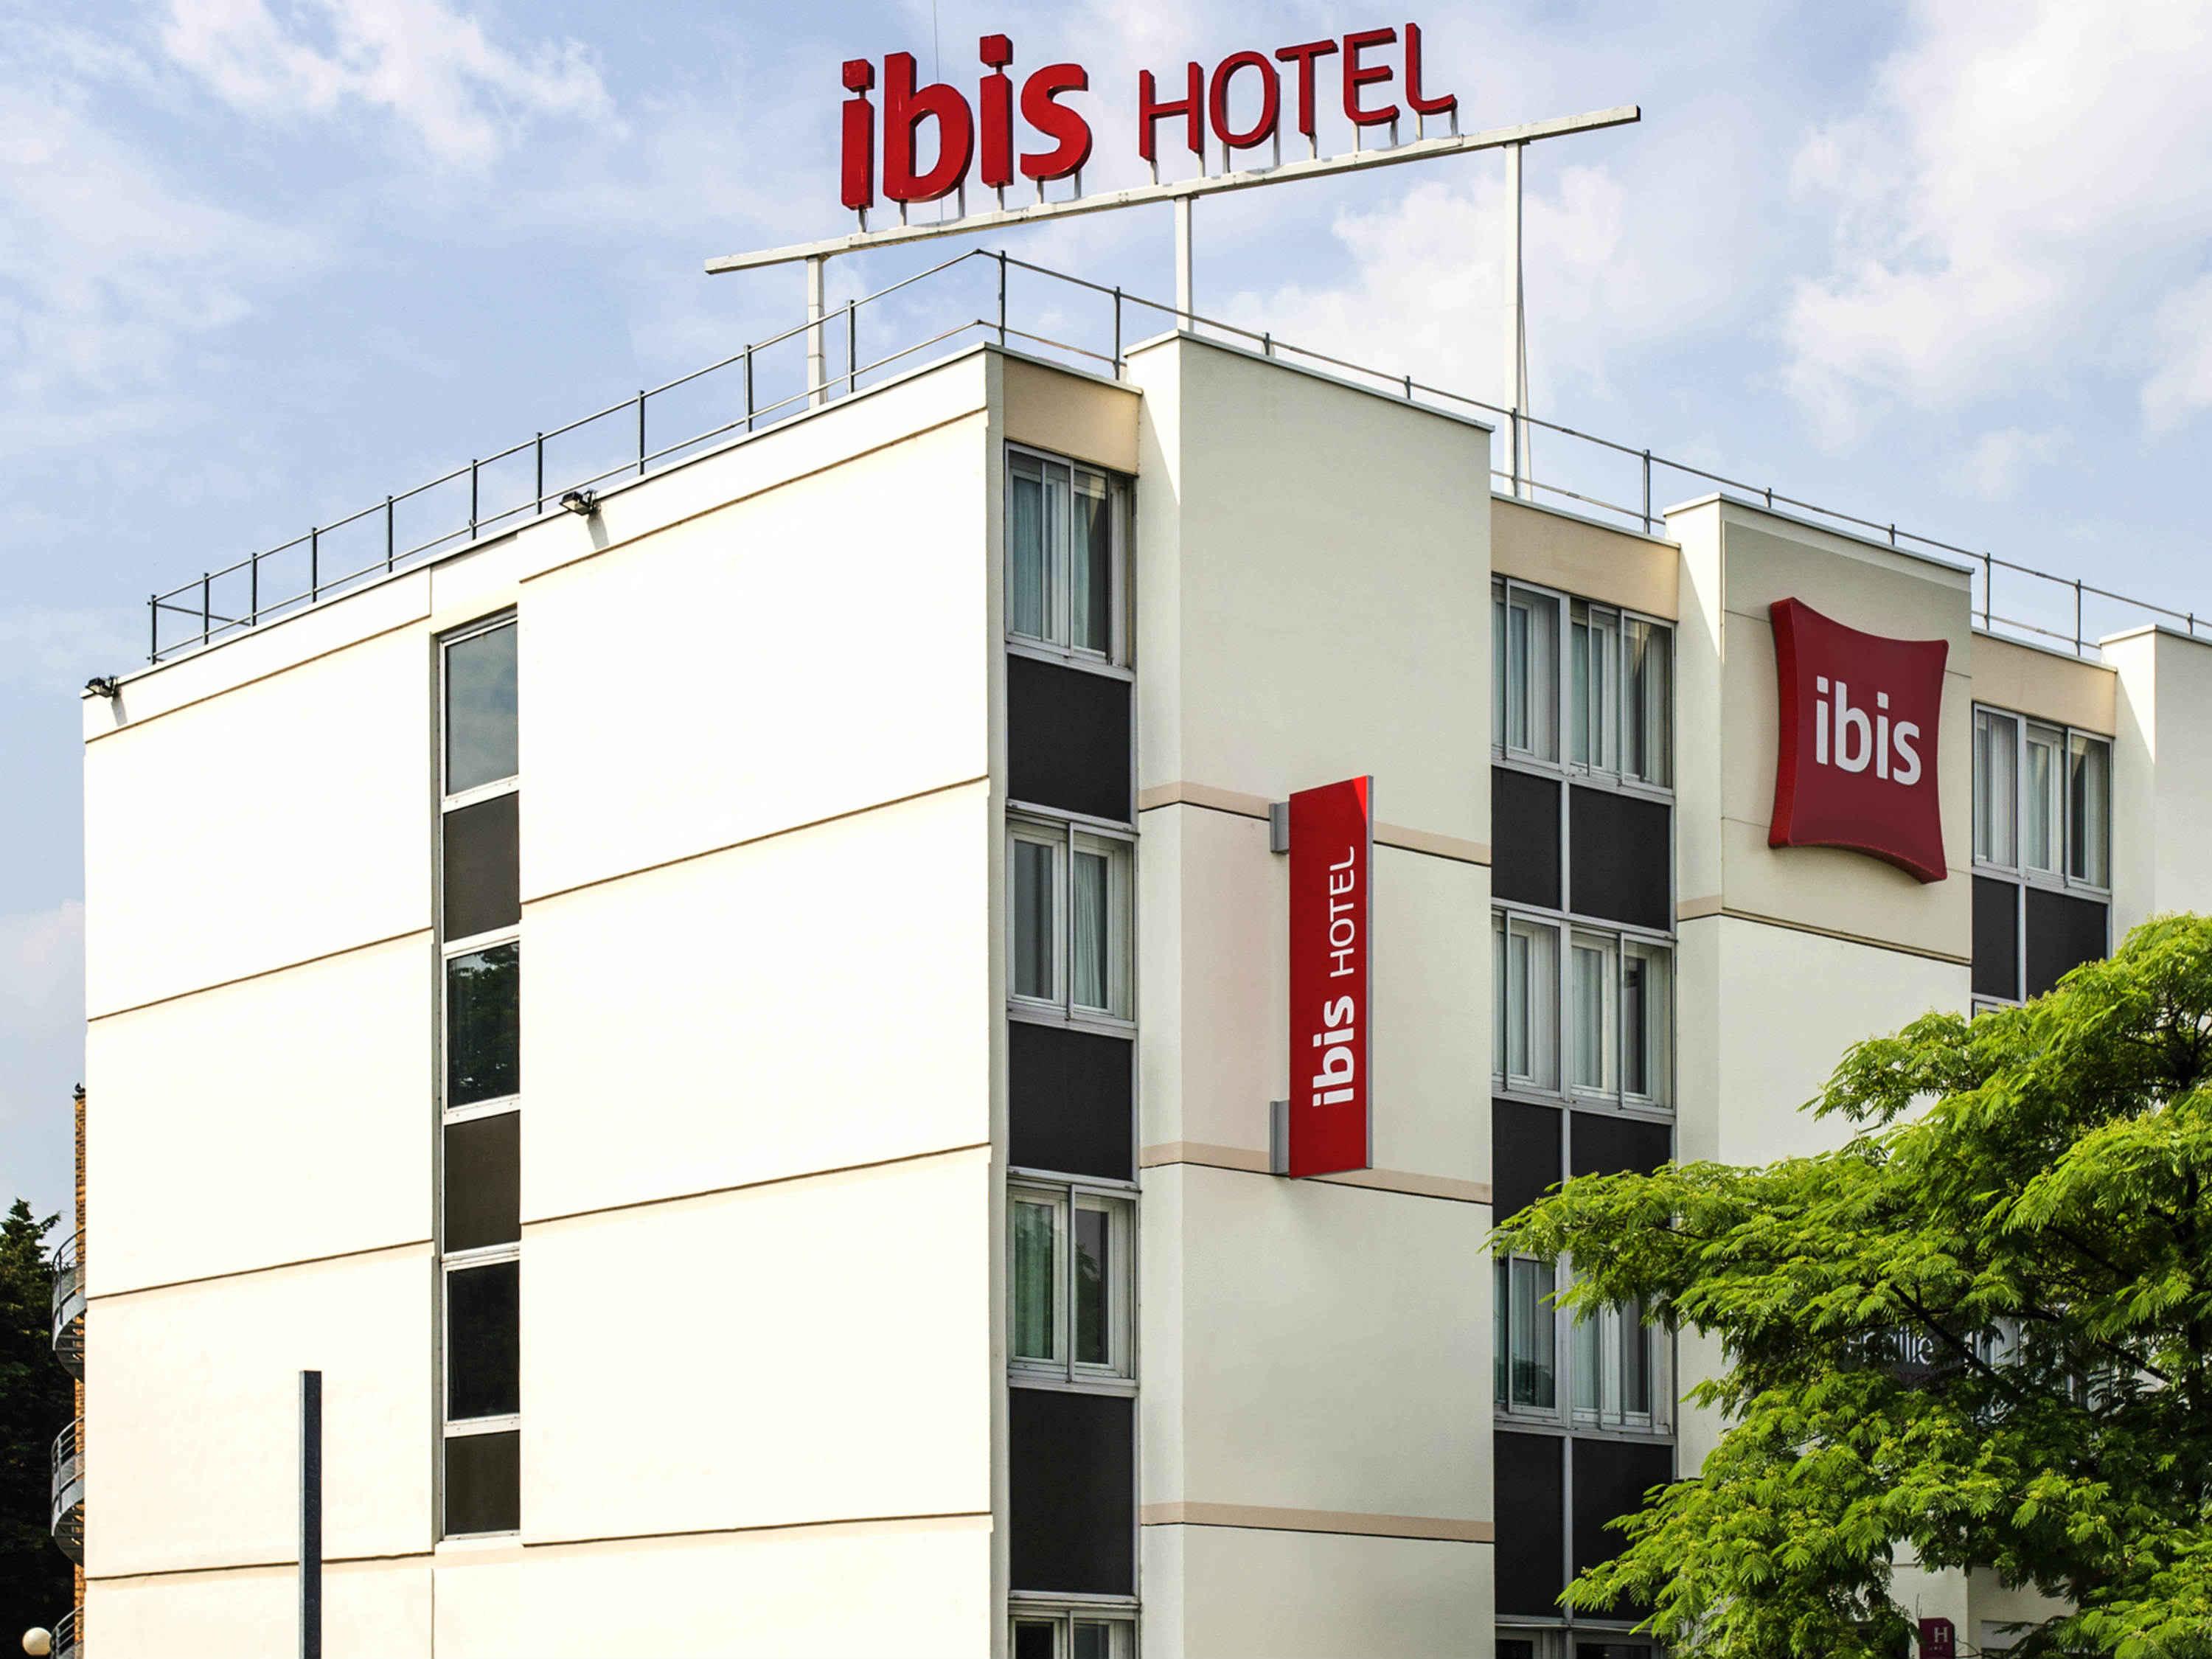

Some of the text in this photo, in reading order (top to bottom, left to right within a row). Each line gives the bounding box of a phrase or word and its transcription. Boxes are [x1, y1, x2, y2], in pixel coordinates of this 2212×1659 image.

[842, 24, 1454, 209] ibis HOTEL
[1817, 676, 1921, 785] ibis
[1313, 846, 1354, 1106] ibis HOTEL
